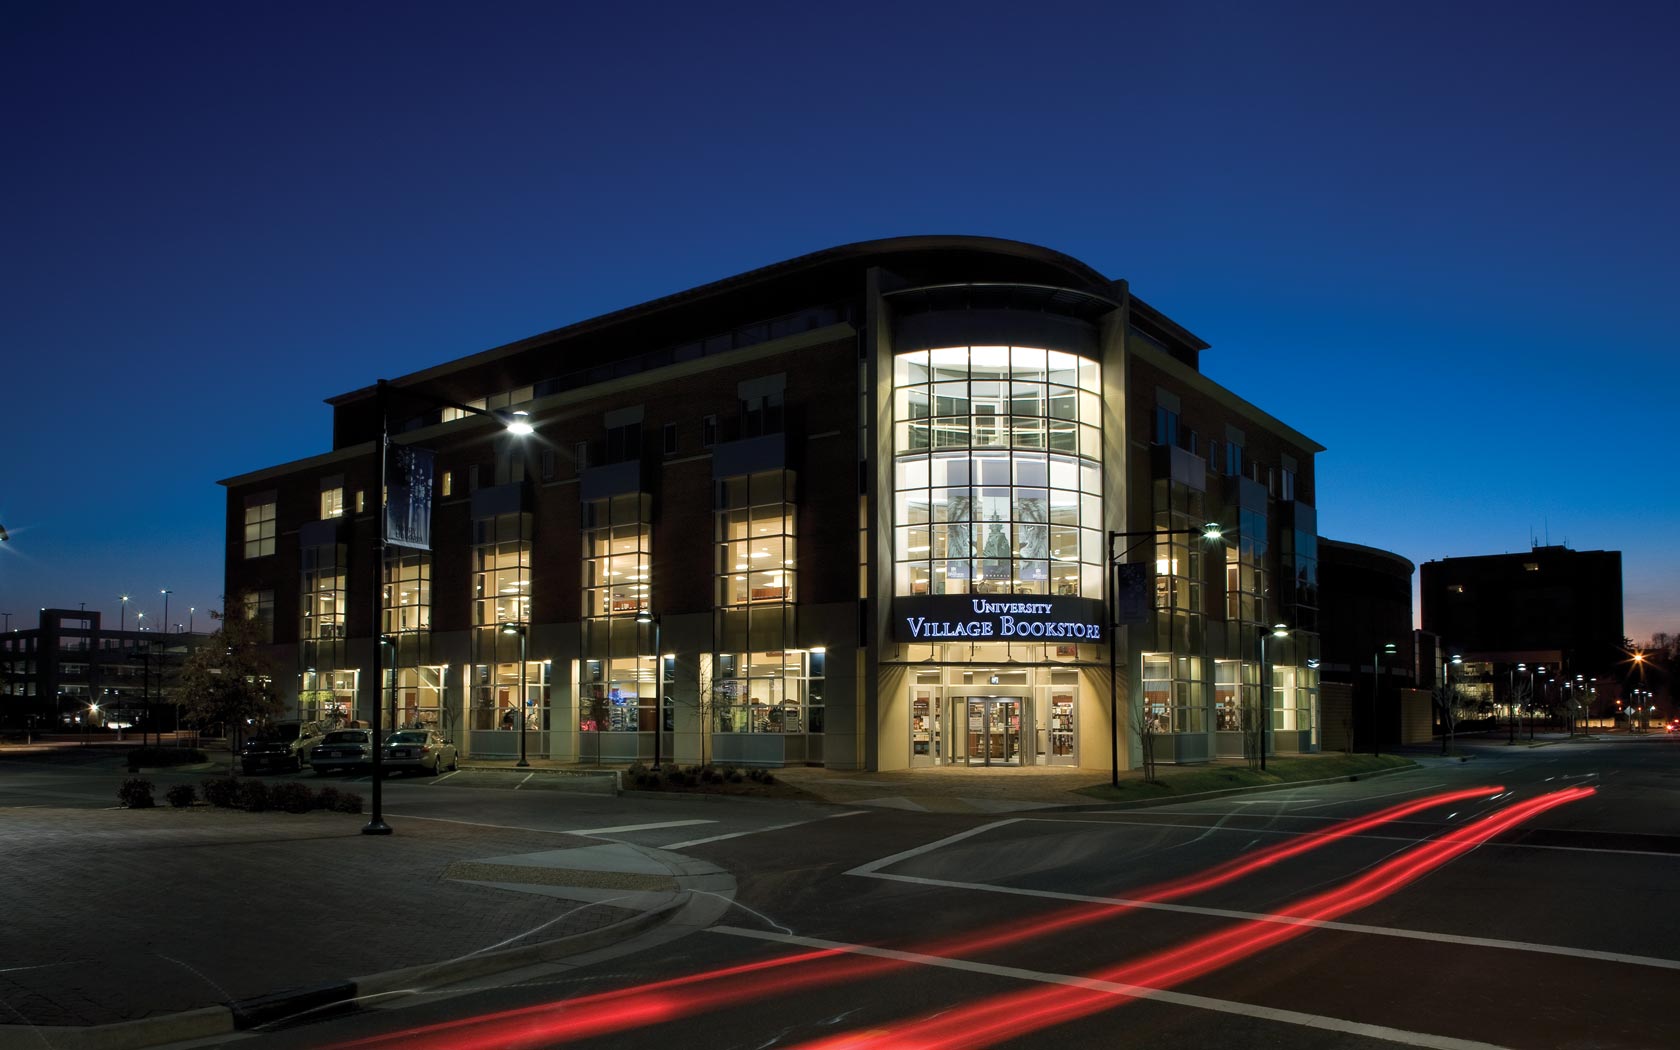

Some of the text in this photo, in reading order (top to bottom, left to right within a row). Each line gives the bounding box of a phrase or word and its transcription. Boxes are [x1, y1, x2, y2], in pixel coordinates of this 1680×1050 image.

[972, 599, 1053, 614] UNIVERSITY
[907, 615, 1101, 639] VILLAGE BOOKSTORE
